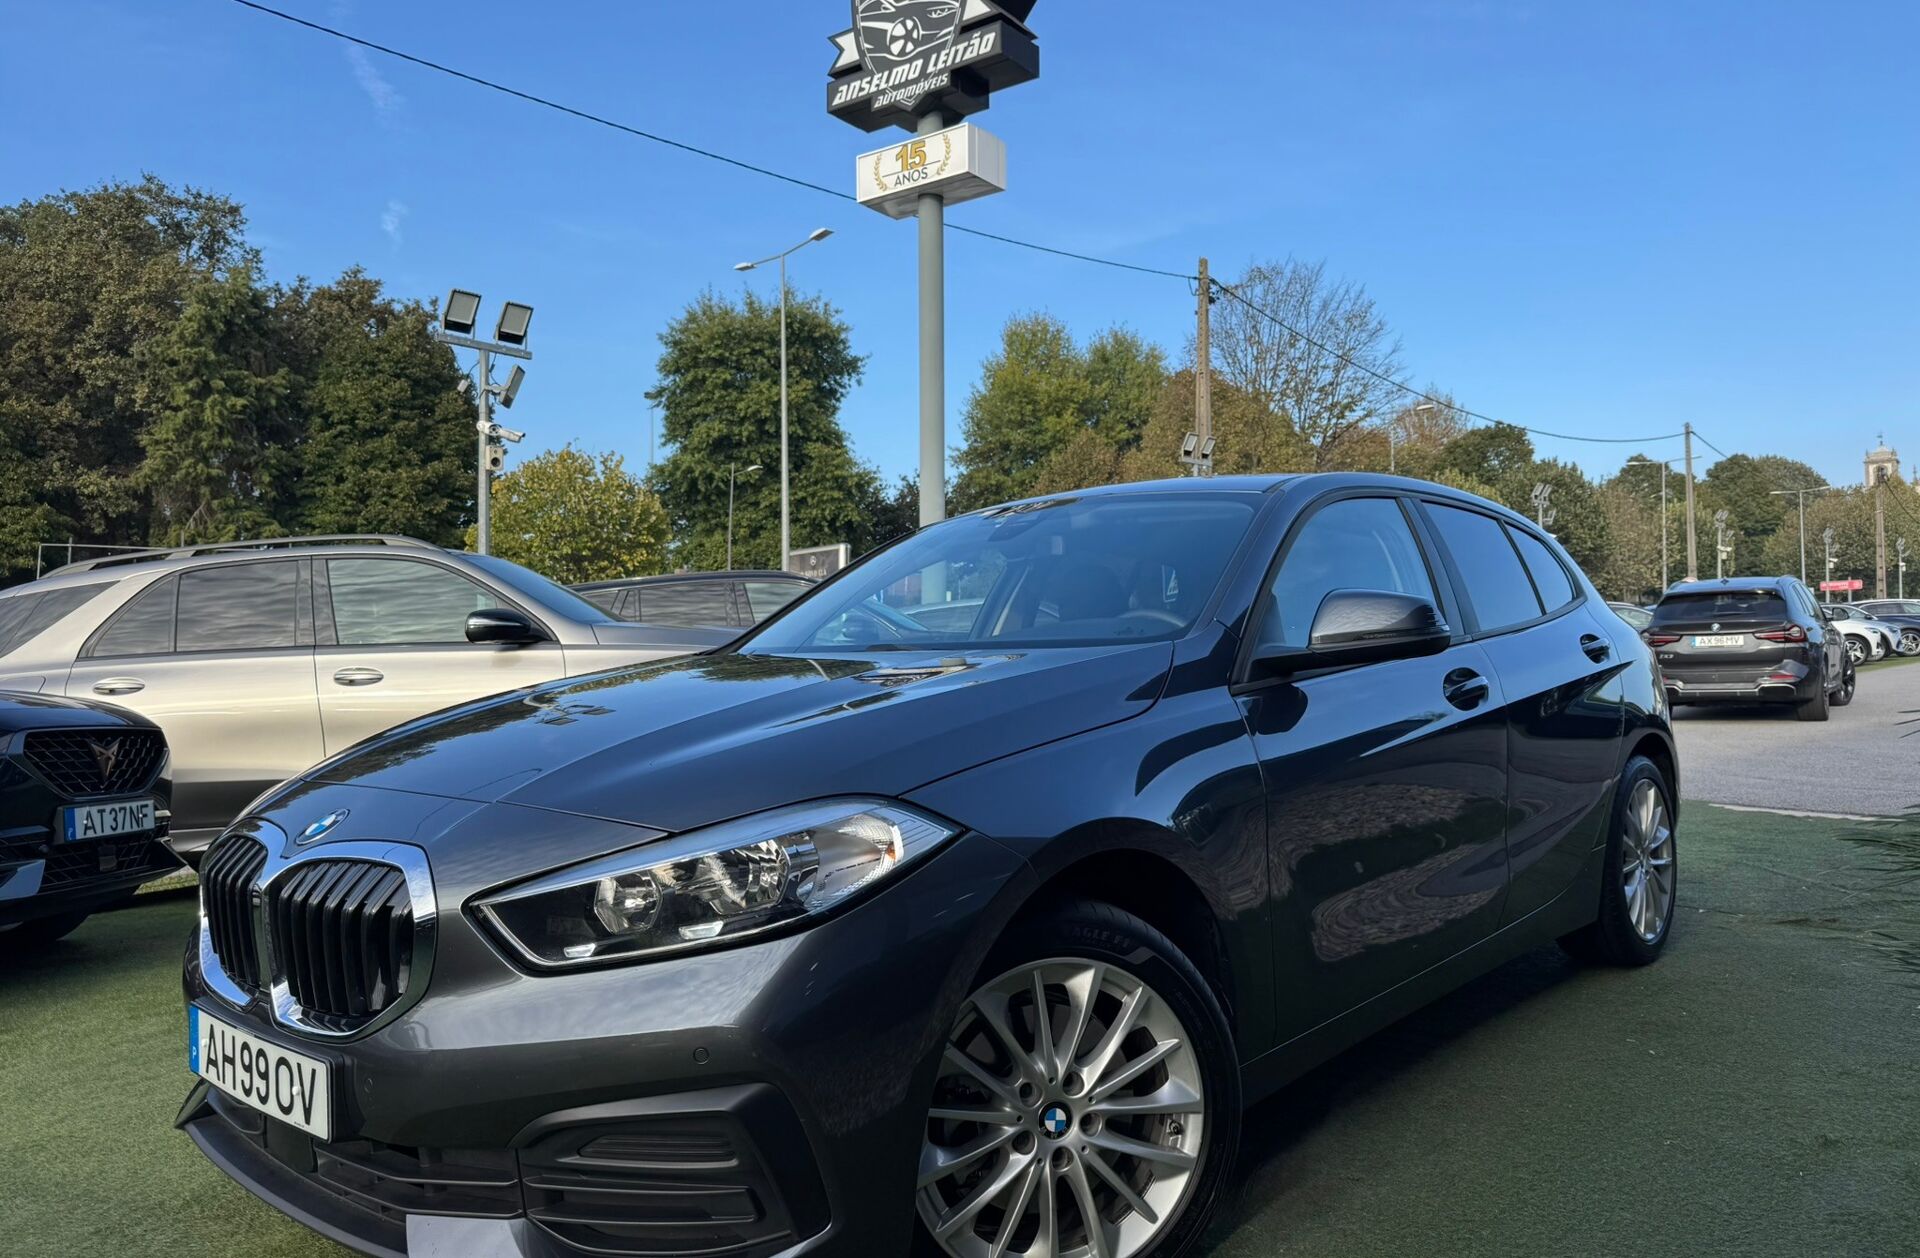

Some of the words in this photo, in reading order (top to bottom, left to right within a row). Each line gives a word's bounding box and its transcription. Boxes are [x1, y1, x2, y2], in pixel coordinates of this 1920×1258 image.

[832, 58, 924, 106] ANSELMO
[926, 31, 996, 74] LEITÃO
[873, 72, 949, 108] AUTOMÓVEIS
[895, 140, 927, 172] 15
[894, 167, 928, 188] ANOS
[83, 804, 149, 836] AT37NF
[205, 1023, 317, 1126] AH99OV
